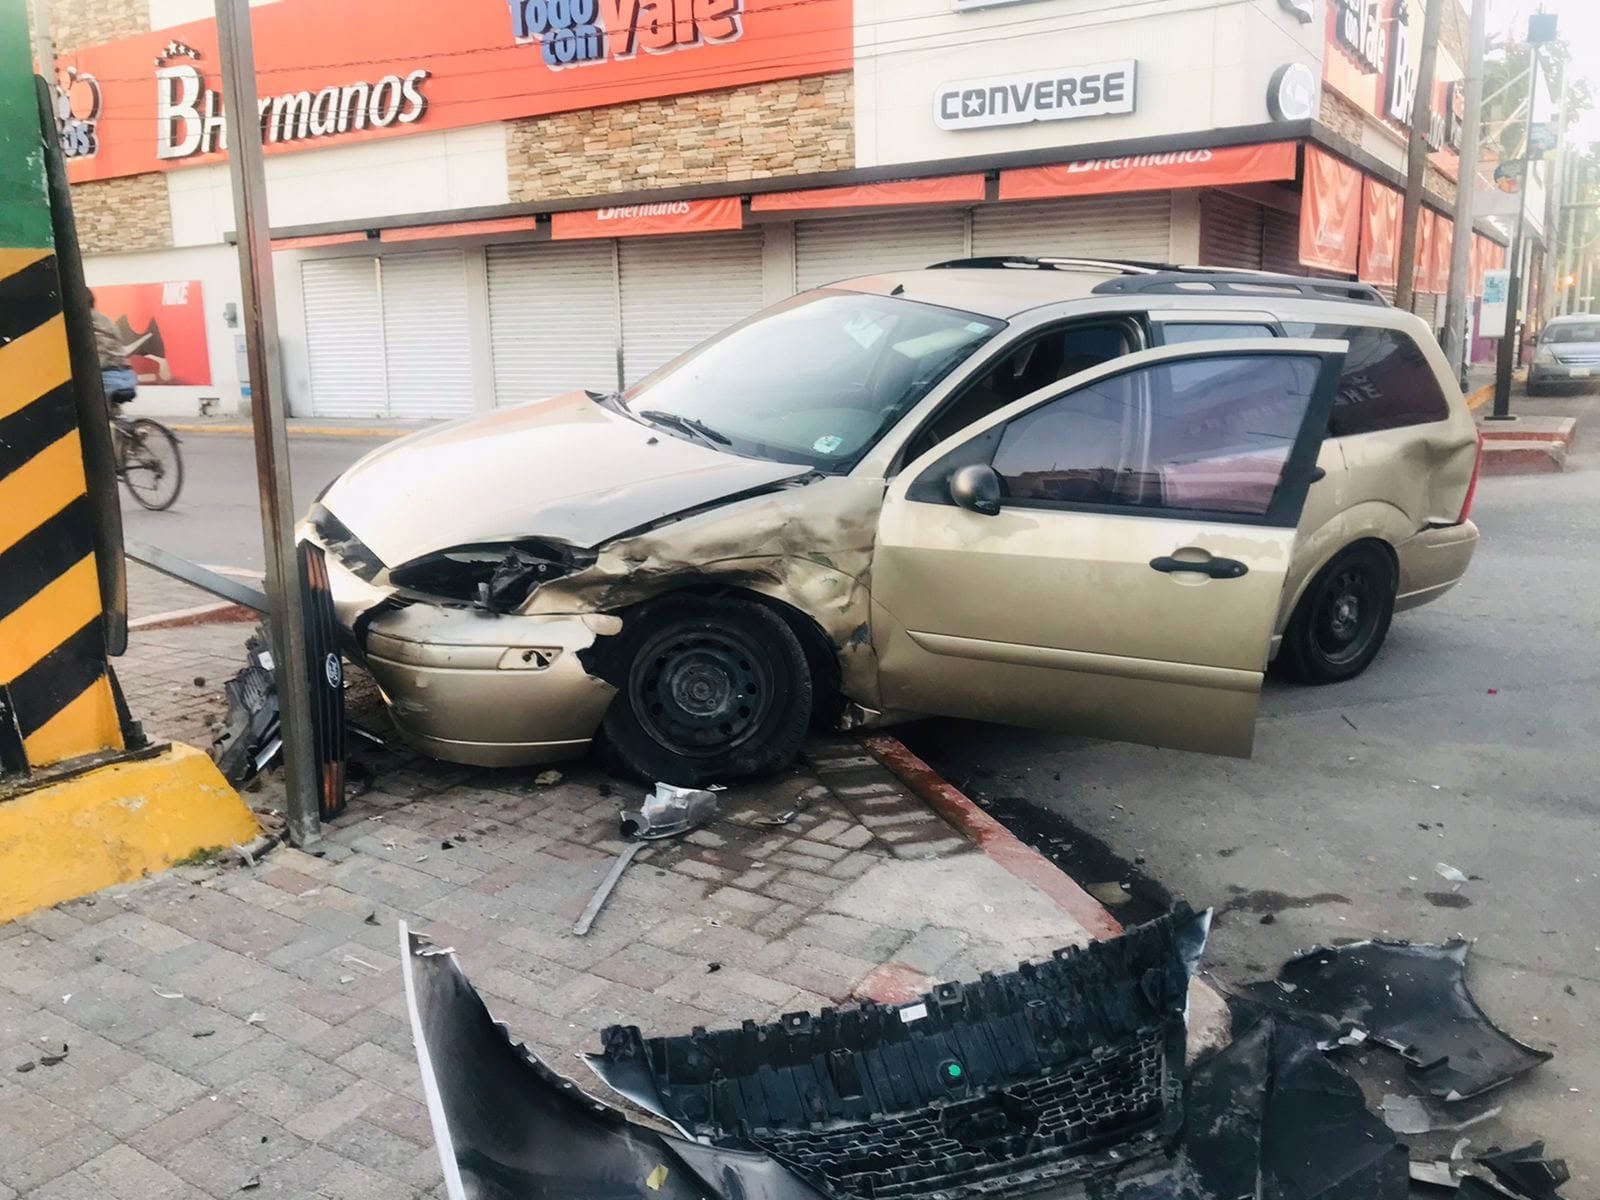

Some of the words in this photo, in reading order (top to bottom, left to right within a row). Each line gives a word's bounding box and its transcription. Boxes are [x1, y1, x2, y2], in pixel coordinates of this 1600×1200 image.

[601, 0, 741, 58] Vale
[155, 65, 428, 160] BHrmanos
[941, 71, 1125, 120] CONVERSE
